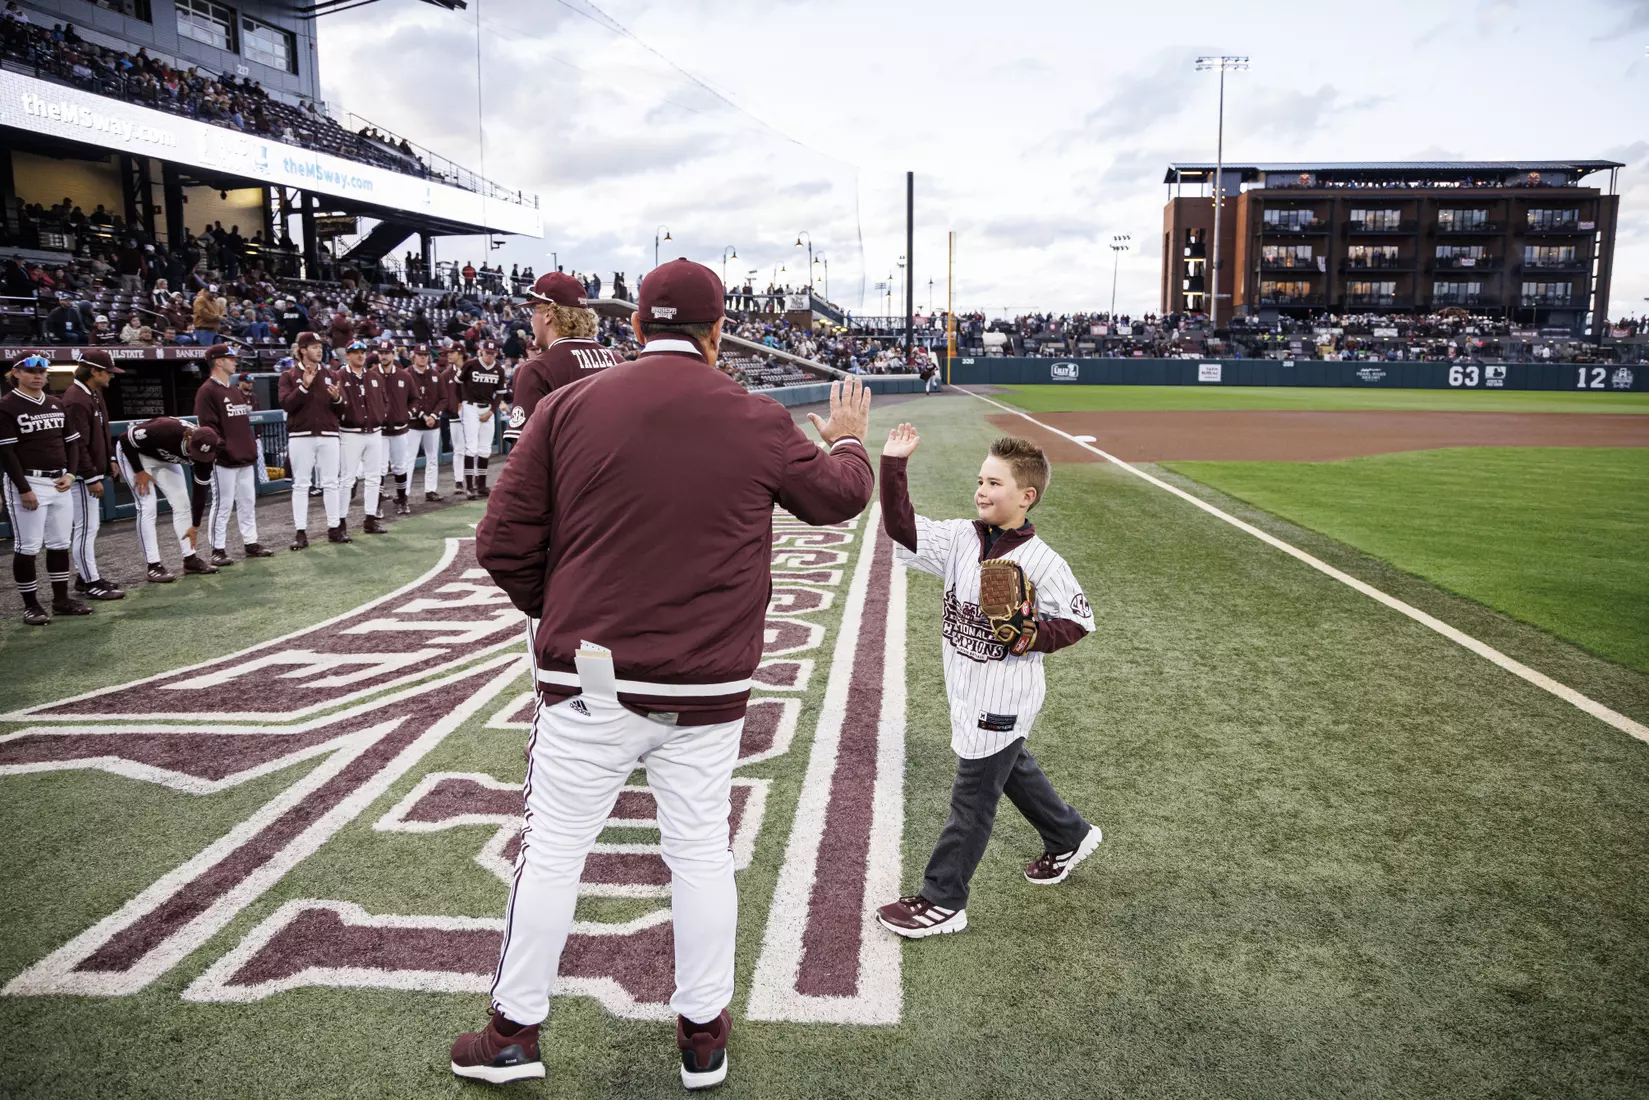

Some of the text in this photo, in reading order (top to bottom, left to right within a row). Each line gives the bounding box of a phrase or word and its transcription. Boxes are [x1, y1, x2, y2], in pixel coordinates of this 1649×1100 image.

[283, 157, 374, 192] theMSway.com
[571, 347, 618, 369] TALLEY
[471, 370, 499, 384] STATE
[1449, 366, 1479, 386] 63
[1577, 367, 1606, 388] 12
[569, 702, 592, 717] adidas
